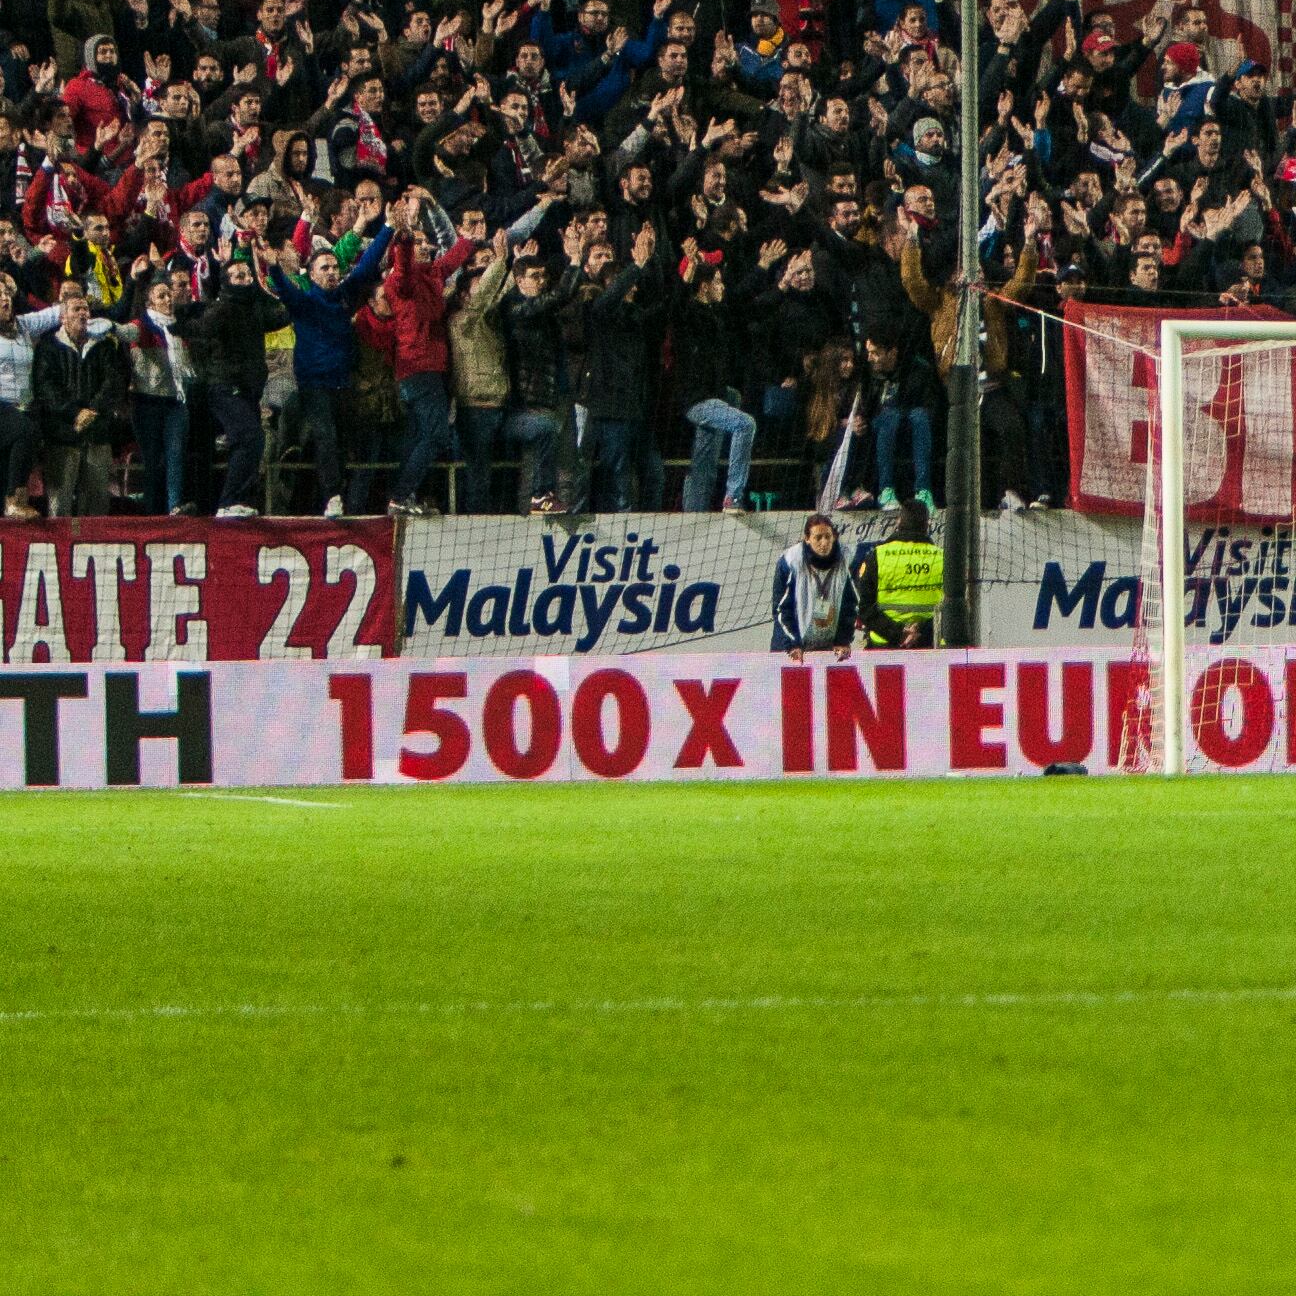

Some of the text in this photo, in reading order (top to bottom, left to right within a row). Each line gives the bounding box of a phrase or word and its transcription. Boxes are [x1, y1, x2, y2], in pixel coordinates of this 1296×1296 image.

[542, 533, 659, 583] Visit
[905, 562, 930, 575] 309
[1182, 525, 1294, 577] Visit
[0, 542, 383, 663] ATE 22
[403, 563, 721, 653] Malaysia
[328, 667, 651, 780] 1500
[781, 664, 907, 773] IN
